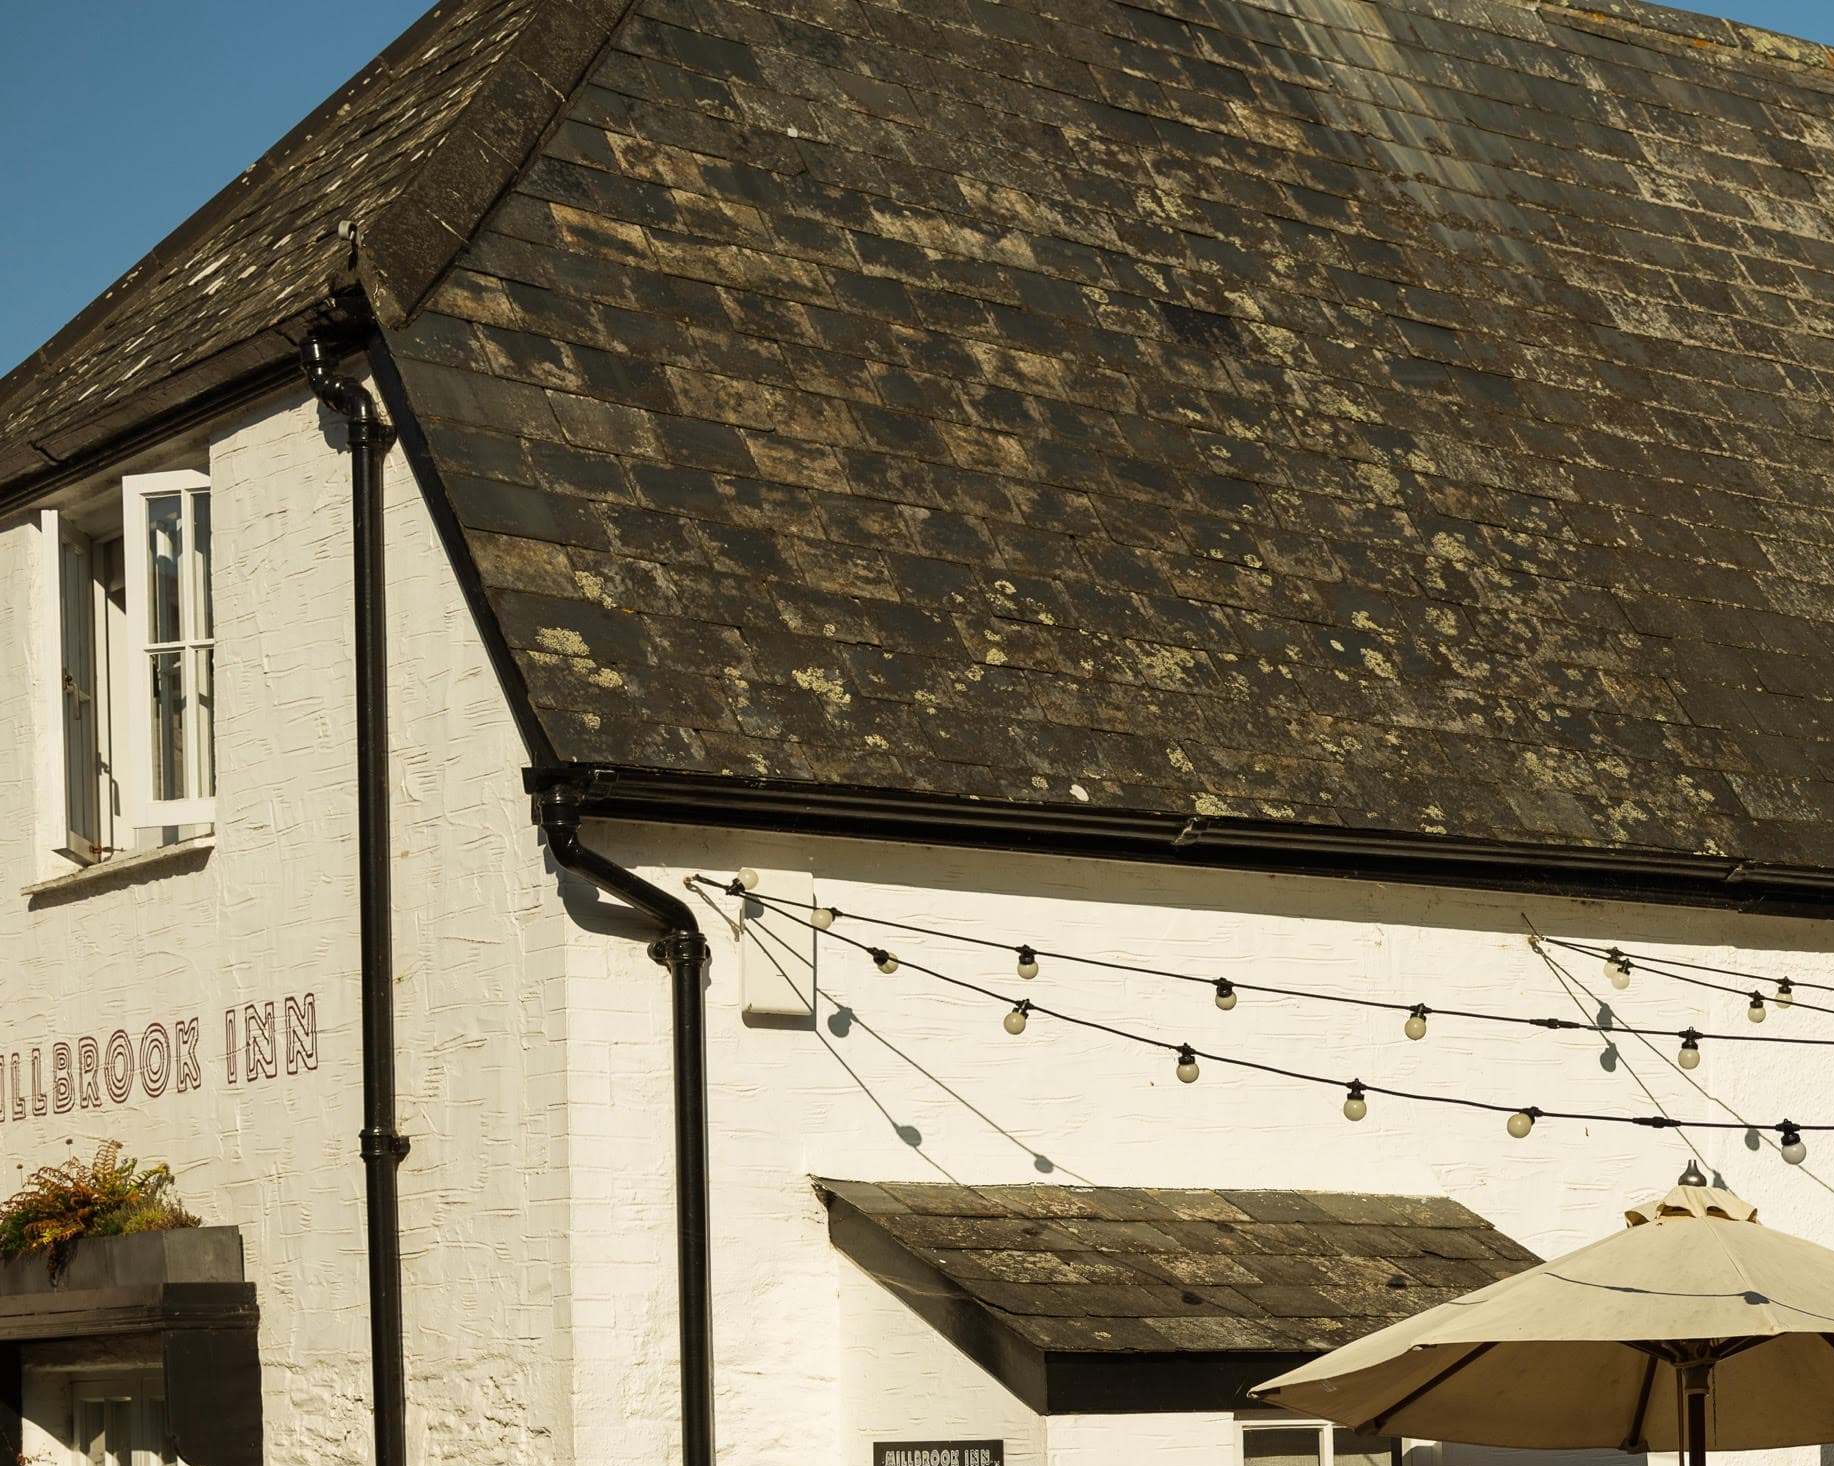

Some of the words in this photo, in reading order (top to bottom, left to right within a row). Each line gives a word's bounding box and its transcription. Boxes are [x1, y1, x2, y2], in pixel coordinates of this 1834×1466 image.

[0, 1016, 202, 1123] ILLBROOK
[225, 992, 320, 1084] INN
[964, 1449, 991, 1466] INN
